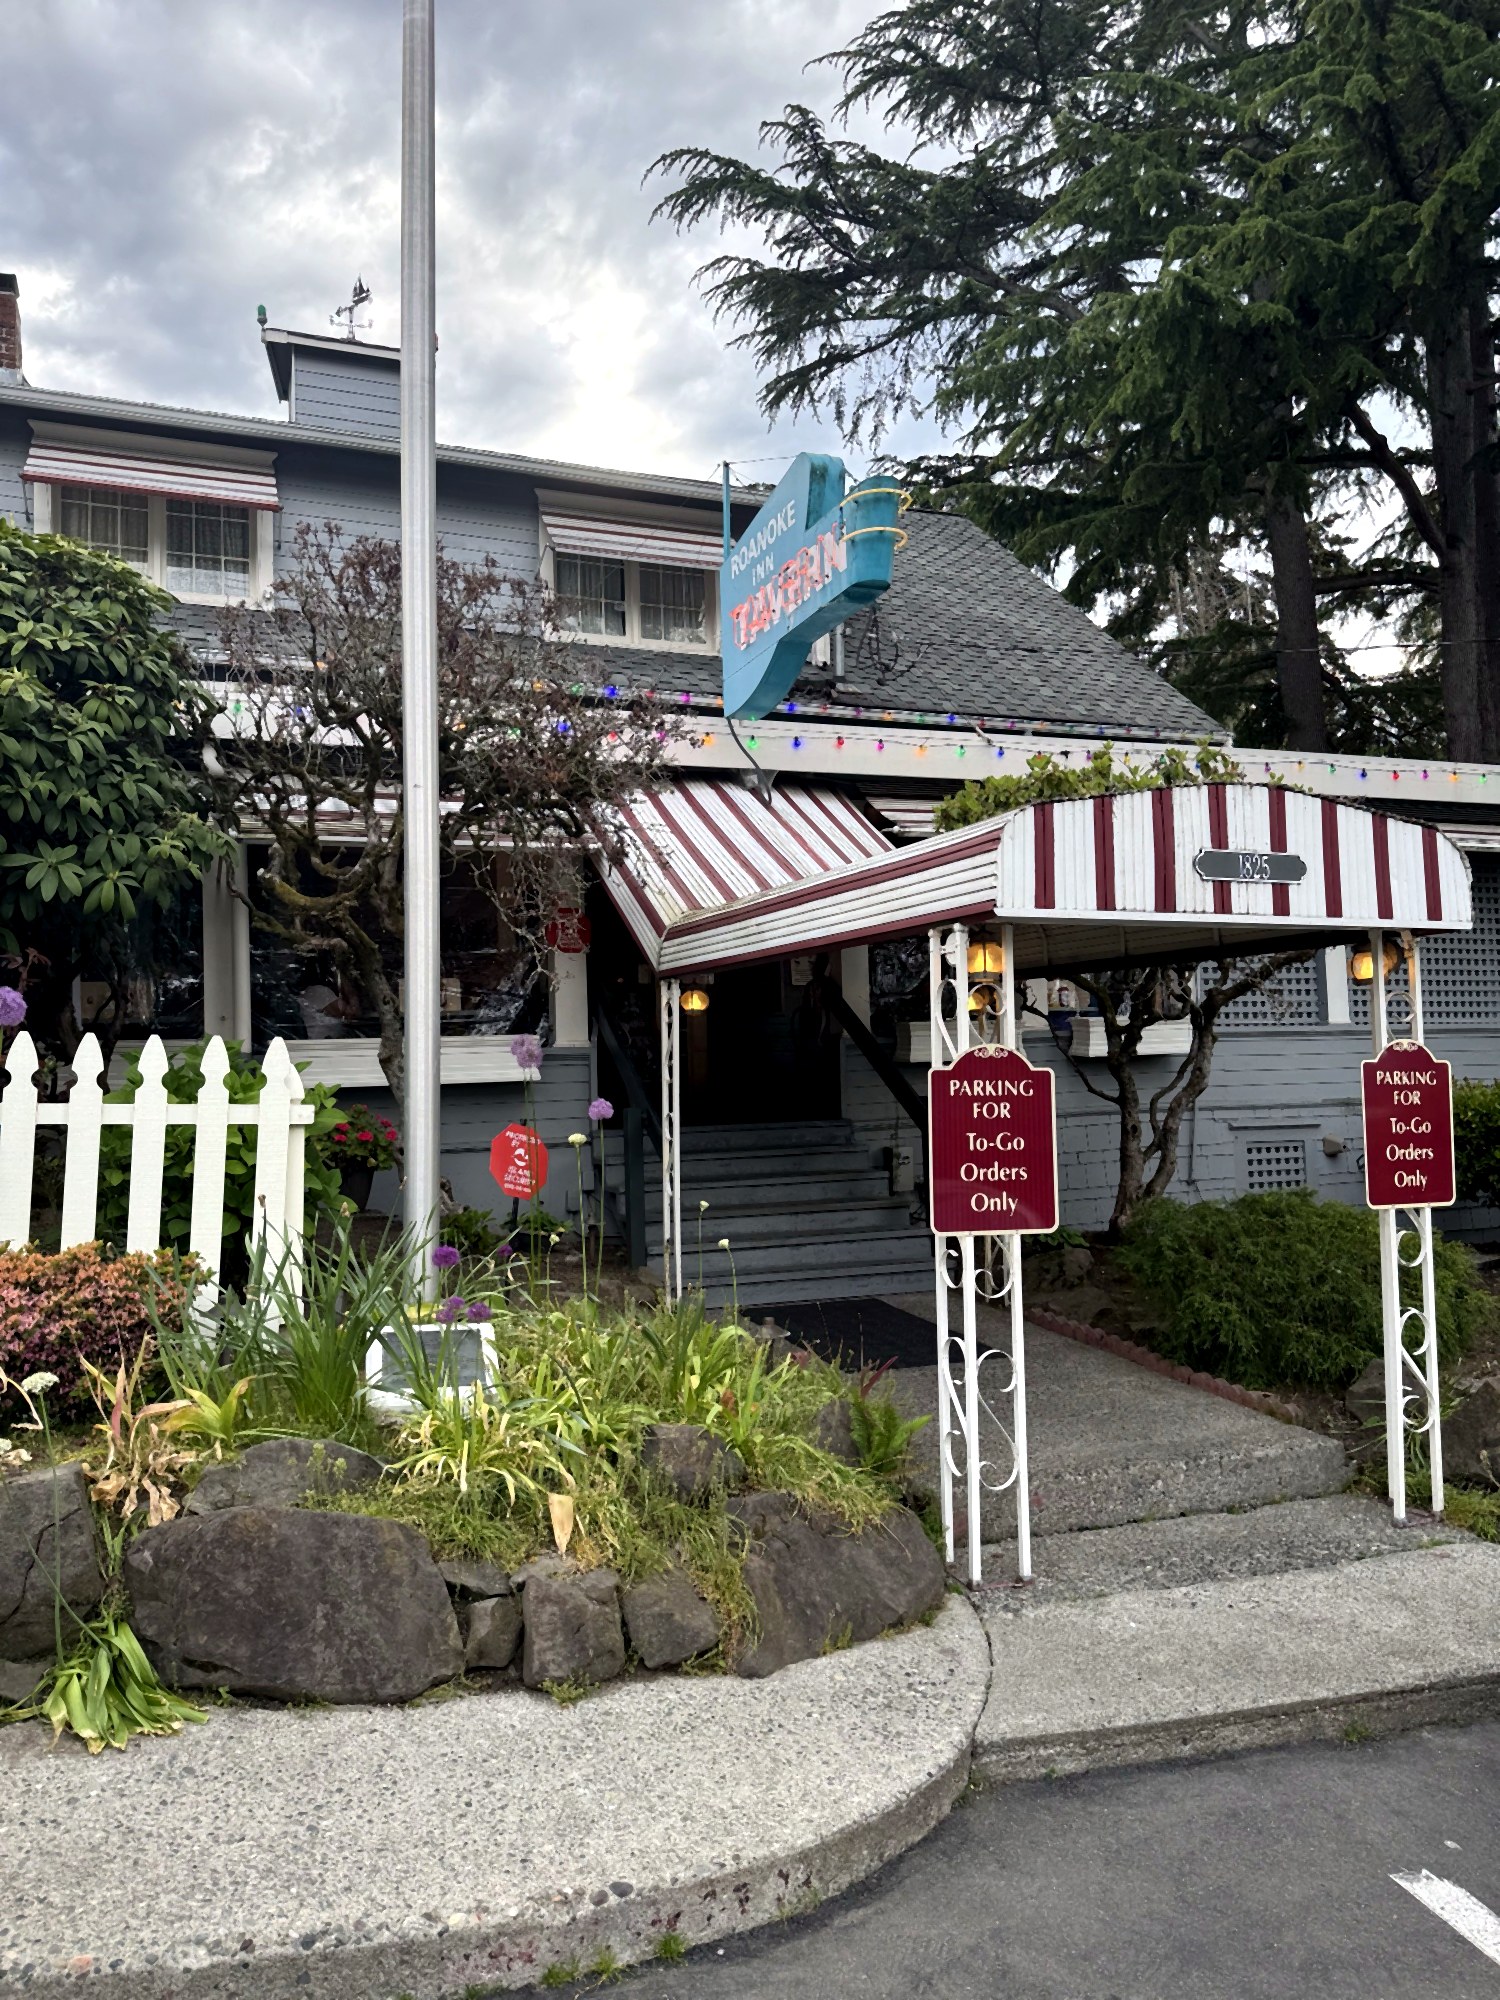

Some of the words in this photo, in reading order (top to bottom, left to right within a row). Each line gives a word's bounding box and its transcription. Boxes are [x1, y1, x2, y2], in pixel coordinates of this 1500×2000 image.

[731, 499, 796, 579] ROANOKE
[752, 554, 774, 586] INN
[729, 521, 848, 651] TAVERN
[1239, 854, 1271, 880] 1825
[949, 1079, 1034, 1097] PARKING
[1376, 1070, 1437, 1086] PARKING
[1393, 1090, 1421, 1106] FOR
[973, 1101, 1011, 1119] FOR
[1389, 1116, 1432, 1134] To-Go
[966, 1131, 1025, 1151] To-Go
[1386, 1143, 1434, 1161] Orders
[960, 1161, 1028, 1182] Orders
[1394, 1169, 1428, 1192] Only
[970, 1191, 1018, 1217] Only
